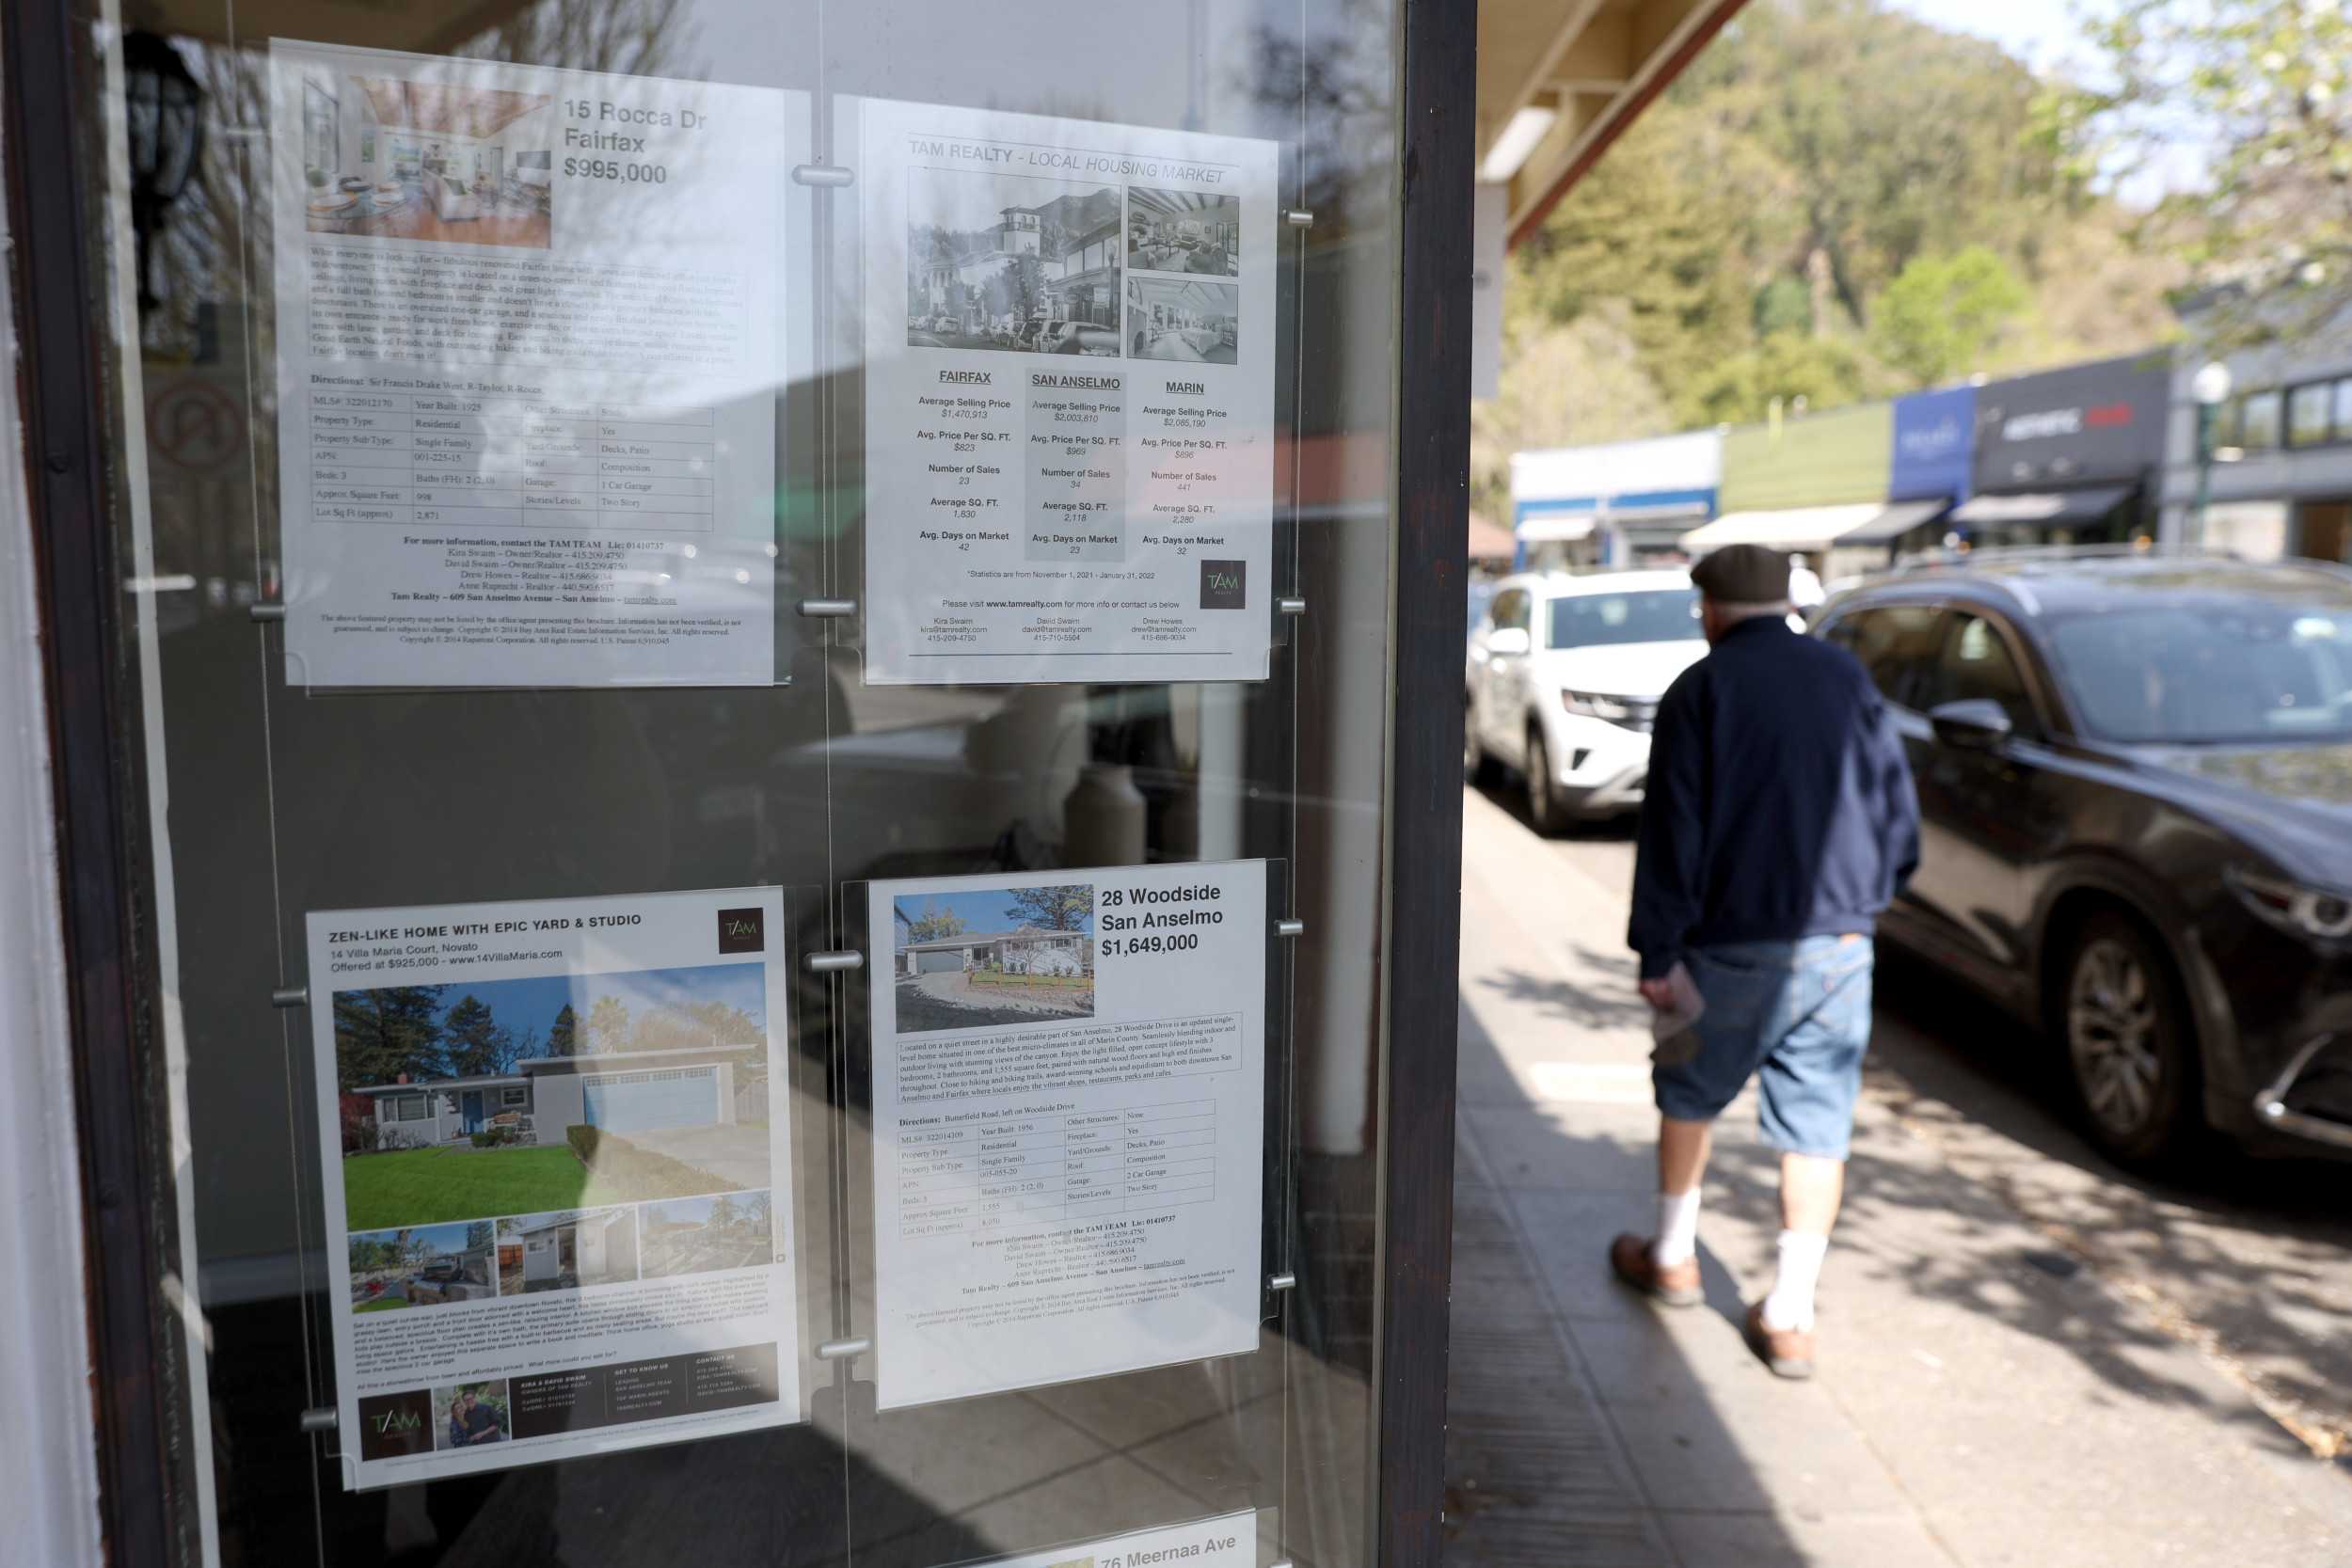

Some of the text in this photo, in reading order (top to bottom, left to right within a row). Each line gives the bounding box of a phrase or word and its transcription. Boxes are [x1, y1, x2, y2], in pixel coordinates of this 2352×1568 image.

[564, 99, 706, 129] 15 Rocca Dr
[564, 127, 645, 152] Fairfax
[909, 140, 943, 156] TAM
[950, 143, 1013, 163] REALTY
[1028, 151, 1081, 171] LOCAL
[1085, 157, 1157, 179] HOUSING
[1161, 165, 1225, 183] MARKET
[563, 156, 666, 184] $995,000
[938, 370, 991, 385] FAIRFAX
[1032, 374, 1120, 389] SAN ANSELMO
[1166, 381, 1204, 395] MARIN
[918, 396, 1010, 408] Average Selling Price
[1032, 400, 1120, 412] Average Selling Price
[941, 408, 987, 419] $1,470,913
[1054, 412, 1098, 423] $2,003,810
[1142, 406, 1227, 418] Average Selling Price
[415, 418, 460, 428] Residential
[1163, 417, 1205, 427] $2,085,190
[916, 430, 1010, 441] Avg. Price Per SQ. FT.
[1030, 434, 1049, 444] Avg.
[1051, 435, 1073, 443] Price
[1075, 436, 1089, 444] Per
[1091, 436, 1106, 445] SQ.
[415, 437, 472, 449] Single Family
[953, 442, 975, 452] $823
[1141, 437, 1158, 447] Avg.
[1161, 438, 1181, 447] Price
[1183, 439, 1197, 447] Per
[1199, 440, 1213, 448] SQ.
[600, 444, 649, 454] Decks, Patio
[1065, 446, 1086, 455] $969
[1174, 449, 1194, 459] $896
[600, 462, 650, 473] Composition
[928, 463, 1000, 474] Number of Sales
[1041, 467, 1075, 477] Number
[1087, 469, 1110, 478] Sales
[958, 476, 969, 485] 23
[1151, 470, 1183, 480] Number
[1195, 472, 1216, 481] Sales
[1070, 480, 1080, 488] 34
[930, 497, 966, 507] Average
[968, 498, 983, 506] SQ.
[1042, 501, 1076, 511] Average
[1078, 502, 1093, 510] SQ.
[953, 509, 976, 518] 1,830
[1152, 503, 1185, 514] Average
[1187, 504, 1201, 513] SQ.
[1063, 513, 1087, 522] 2,118
[1172, 515, 1194, 524] 2,280
[919, 530, 939, 540] Avg.
[941, 531, 963, 541] Days
[978, 531, 1009, 540] Market
[1031, 534, 1050, 543] Avg.
[1053, 534, 1073, 544] Days
[1088, 535, 1117, 543] Market
[1142, 535, 1160, 545] Avg.
[1162, 536, 1182, 545] Days
[1196, 536, 1224, 544] Market
[403, 536, 420, 544] For
[446, 537, 499, 546] information,
[548, 539, 570, 548] TAM
[572, 540, 601, 548] TEAM
[985, 600, 1062, 609] www.tamrealty.com
[1101, 884, 1220, 906] 28 Woodside
[1101, 909, 1223, 931] San Anselmo
[329, 914, 641, 943] ZEN-LIKE HOME WITH EPIC YARD & STUDIO
[331, 942, 478, 958] 14 Villa Maria Court, Novato
[1101, 933, 1198, 957] $1,649,000
[331, 961, 371, 972] Offered
[375, 960, 385, 969] at
[388, 956, 439, 969] $925,000
[449, 950, 562, 964] www.14VillaMaria.com
[899, 1116, 940, 1126] Directions:
[944, 1112, 980, 1122] Butterfield
[981, 1110, 1000, 1118] Road,
[1023, 1104, 1055, 1113] Woodside
[1018, 1123, 1033, 1131] 1956
[981, 1140, 1016, 1151] Residential
[1126, 1153, 1165, 1164] Composition
[1101, 1536, 1236, 1568] 76 Meernaa Ave
